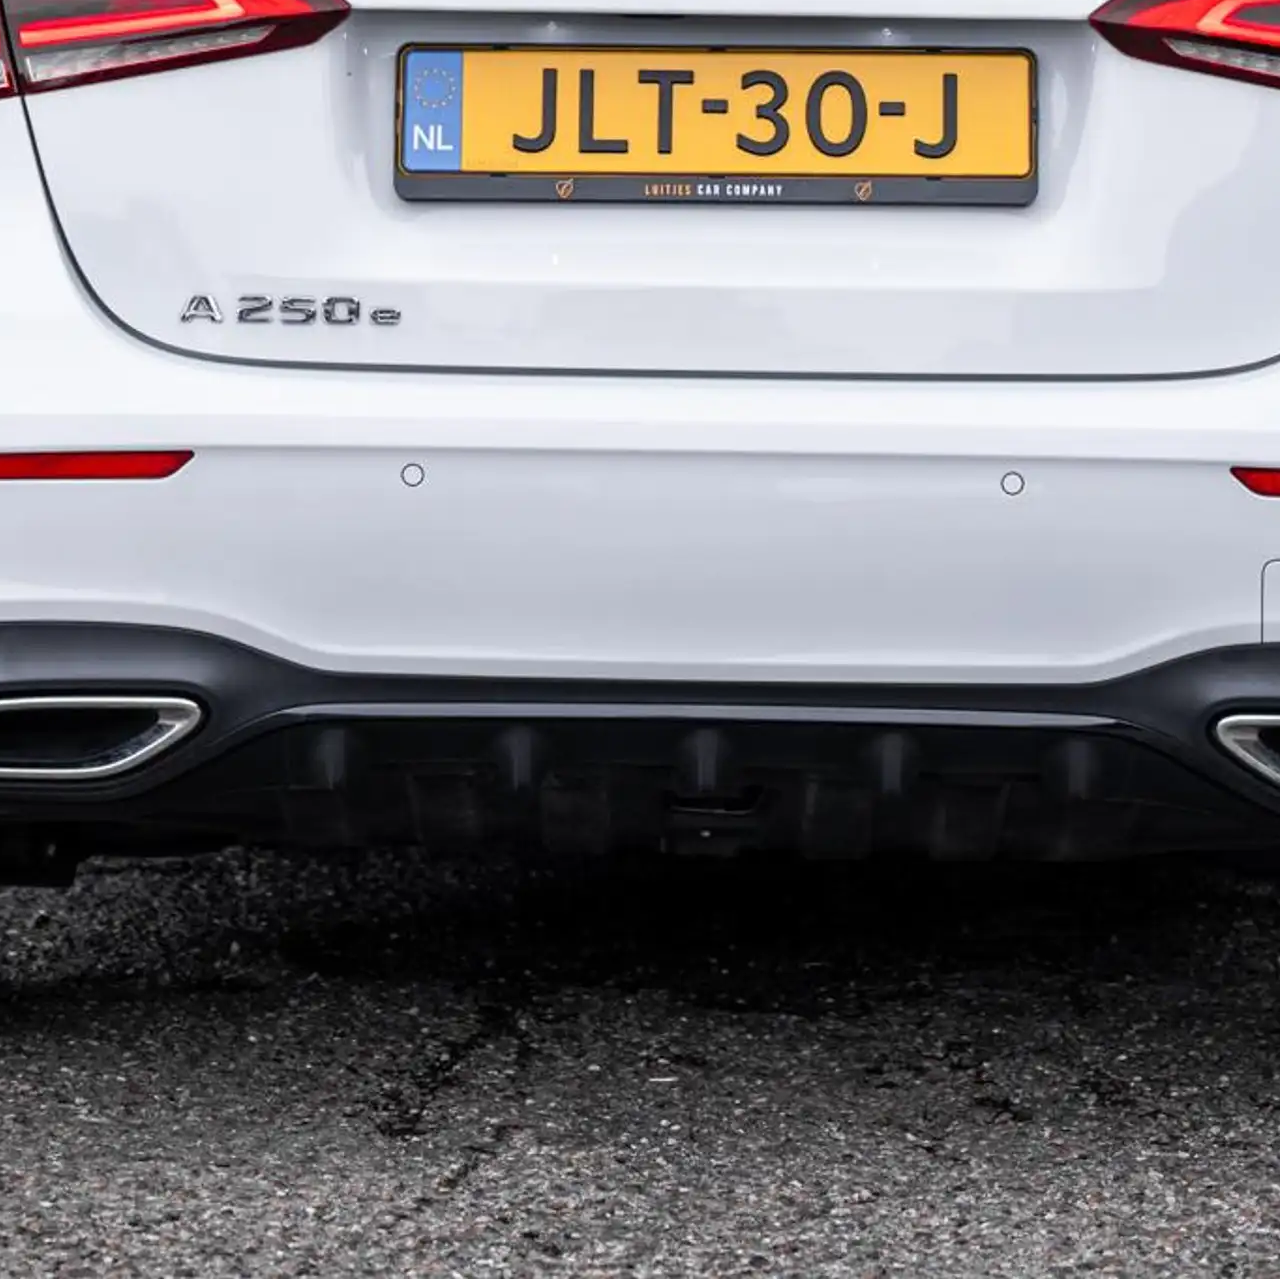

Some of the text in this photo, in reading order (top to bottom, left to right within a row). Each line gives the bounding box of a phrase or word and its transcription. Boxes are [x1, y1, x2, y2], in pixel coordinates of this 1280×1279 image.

[412, 67, 959, 160] NL JLT-30-J
[697, 183, 720, 197] CAR
[725, 183, 783, 197] COMPANY
[180, 294, 224, 324] A
